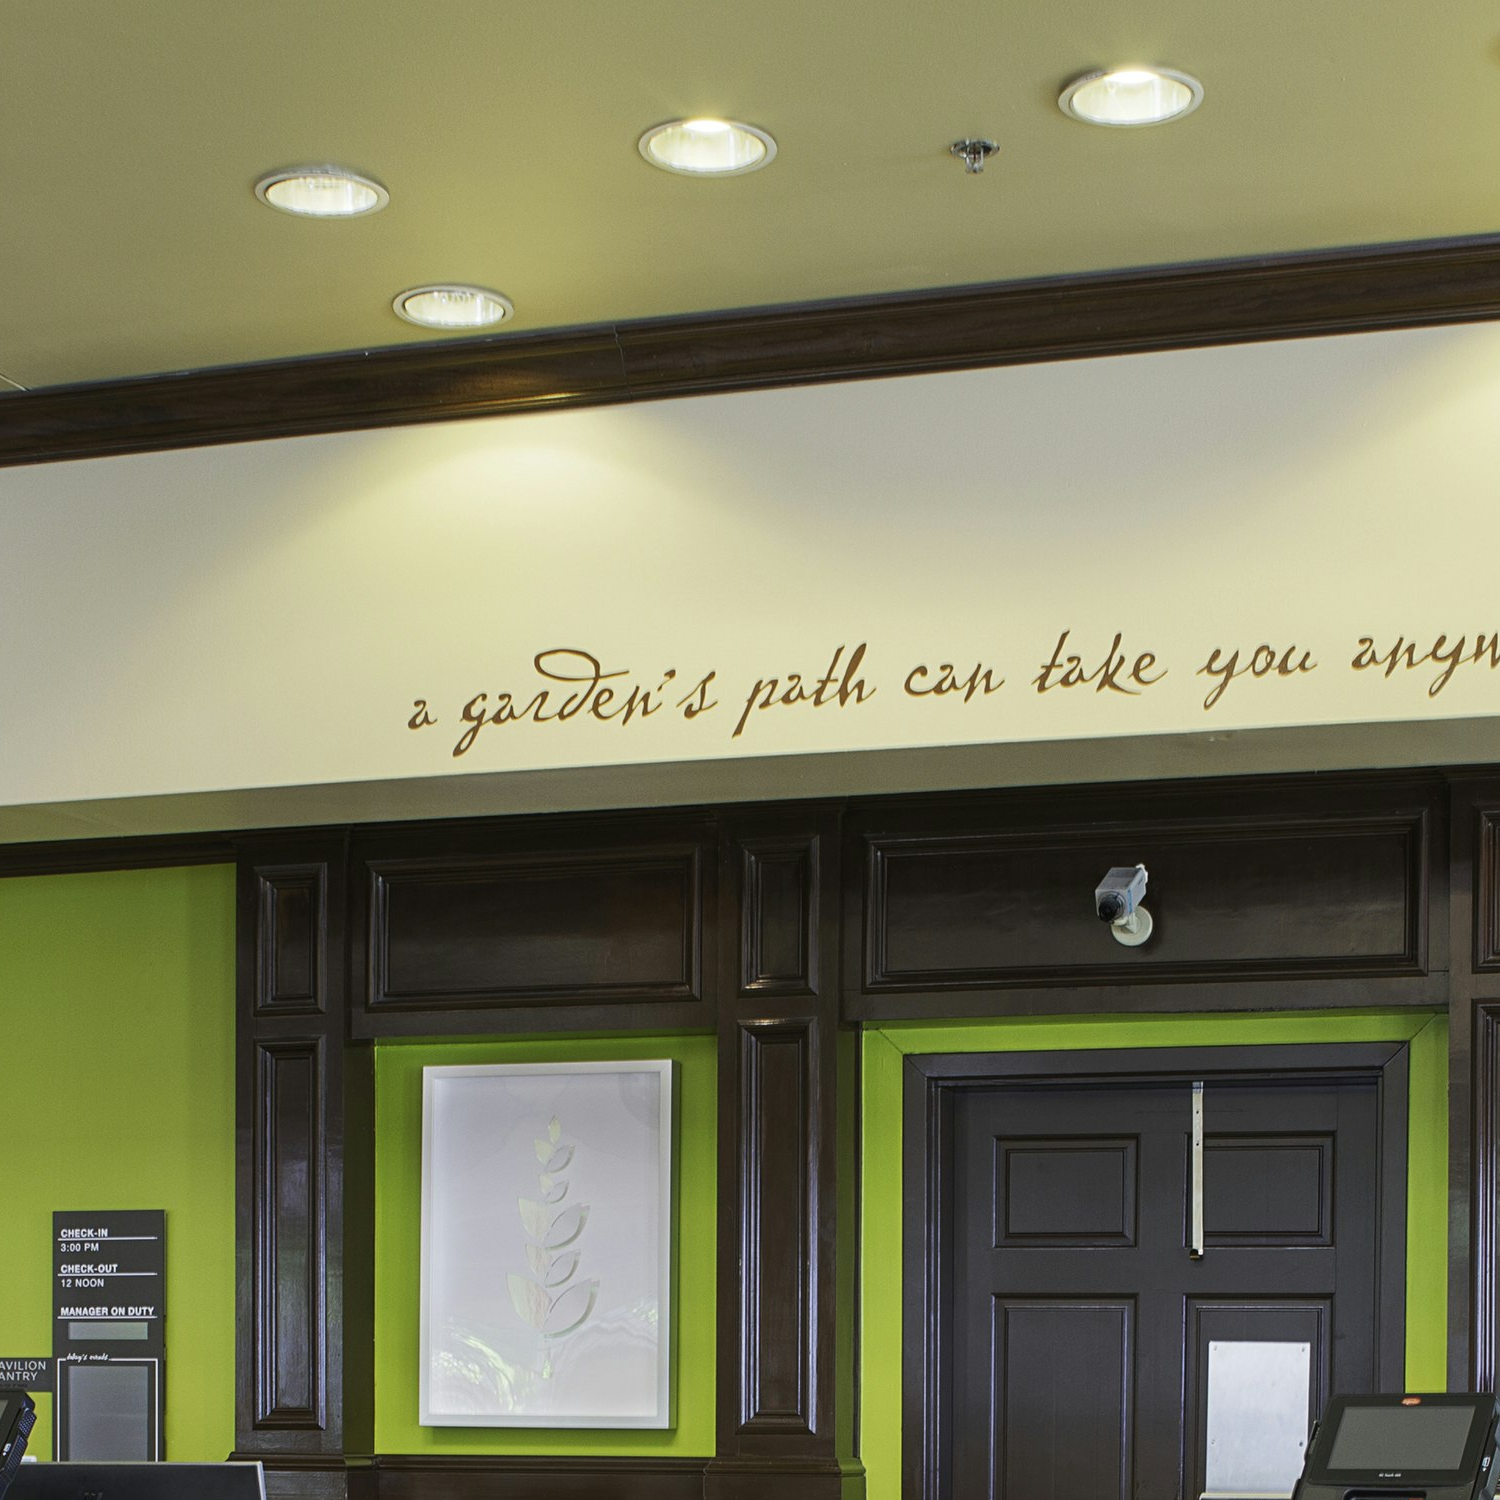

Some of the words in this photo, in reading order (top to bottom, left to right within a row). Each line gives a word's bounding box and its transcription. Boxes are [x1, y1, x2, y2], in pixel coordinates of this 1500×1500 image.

[408, 700, 438, 730] a
[452, 648, 719, 757] garden's
[732, 642, 877, 738] path
[903, 661, 1005, 703] can
[1032, 628, 1168, 695] take
[1197, 642, 1318, 710] you
[60, 1228, 109, 1238] CHECK-IN
[60, 1243, 81, 1252] 3:00
[84, 1243, 100, 1252] PM
[60, 1264, 118, 1273] CHECK-OUT
[61, 1279, 72, 1288] 12
[75, 1278, 105, 1288] NOON
[60, 1306, 109, 1316] MANAGER
[110, 1306, 126, 1316] ON
[127, 1306, 155, 1316] DUTY
